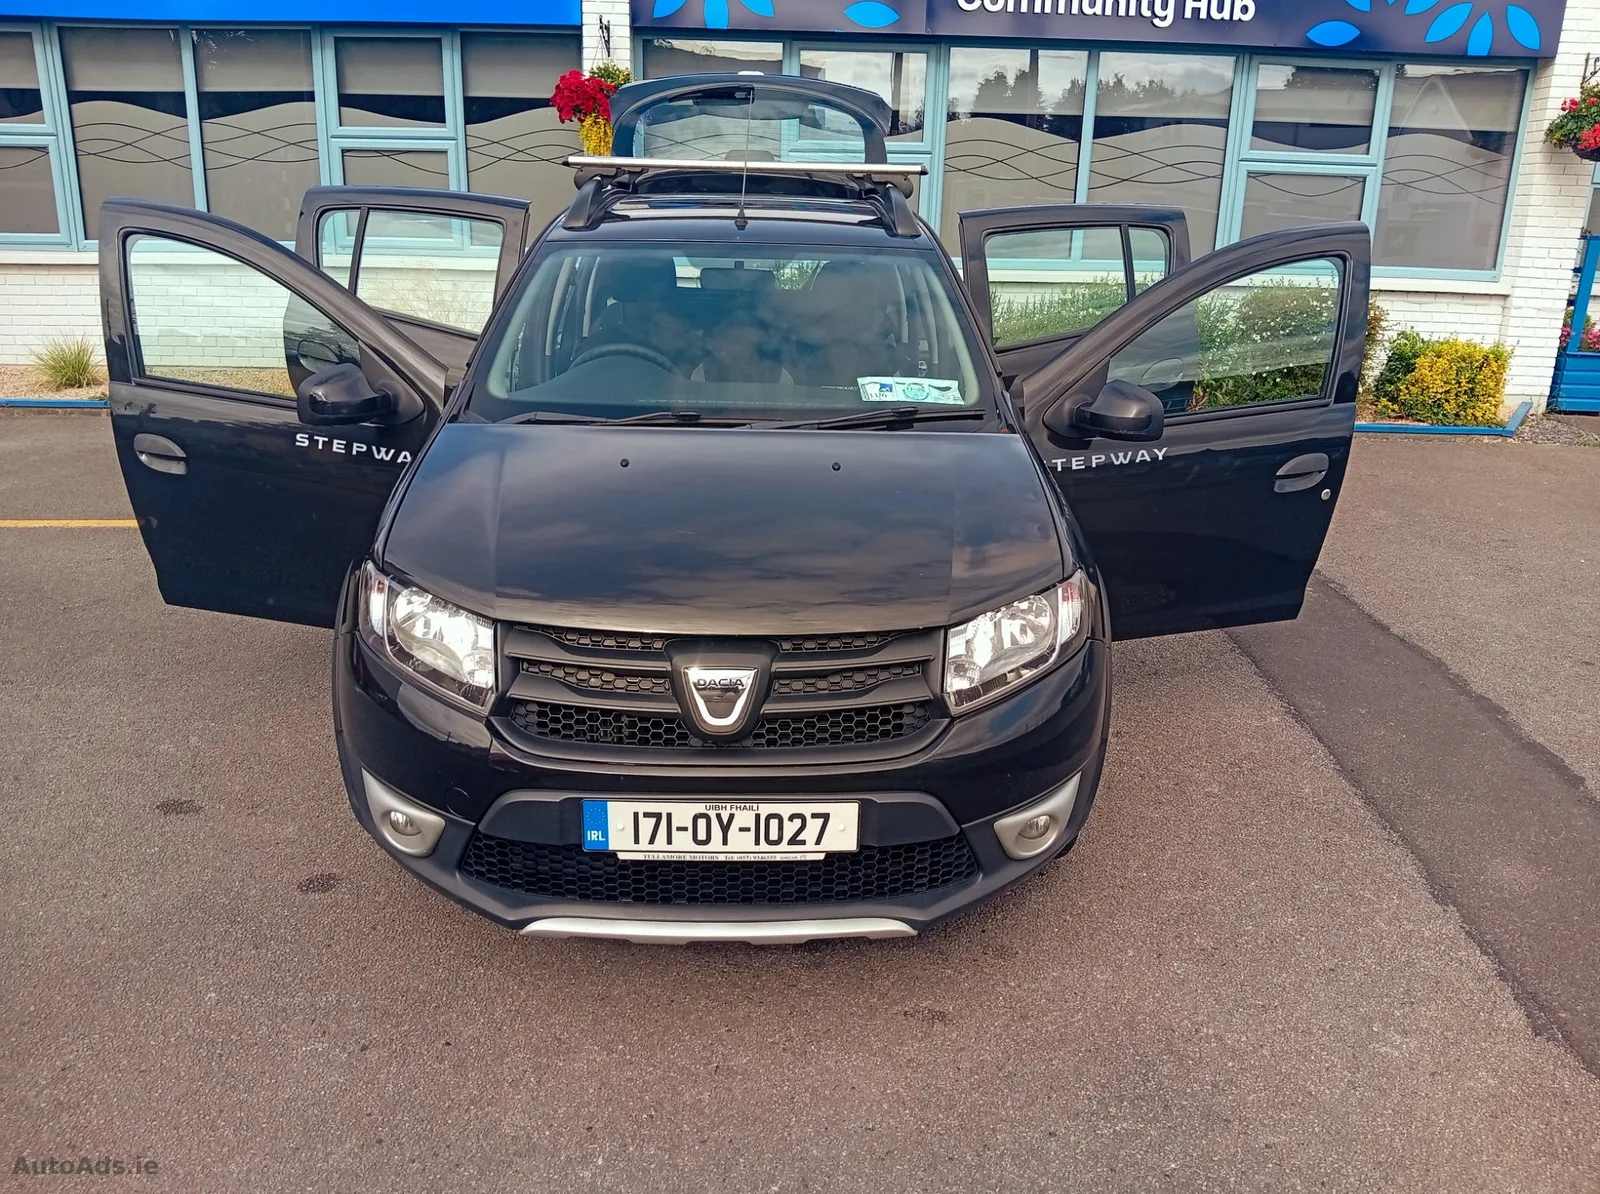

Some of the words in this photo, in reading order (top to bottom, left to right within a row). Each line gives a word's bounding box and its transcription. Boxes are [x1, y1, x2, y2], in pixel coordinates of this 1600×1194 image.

[1184, 0, 1256, 22] Hub
[1044, 446, 1169, 472] TEPWAY
[696, 678, 745, 688] DACIA
[587, 830, 606, 841] IRL
[632, 811, 831, 847] 171-OY-1027
